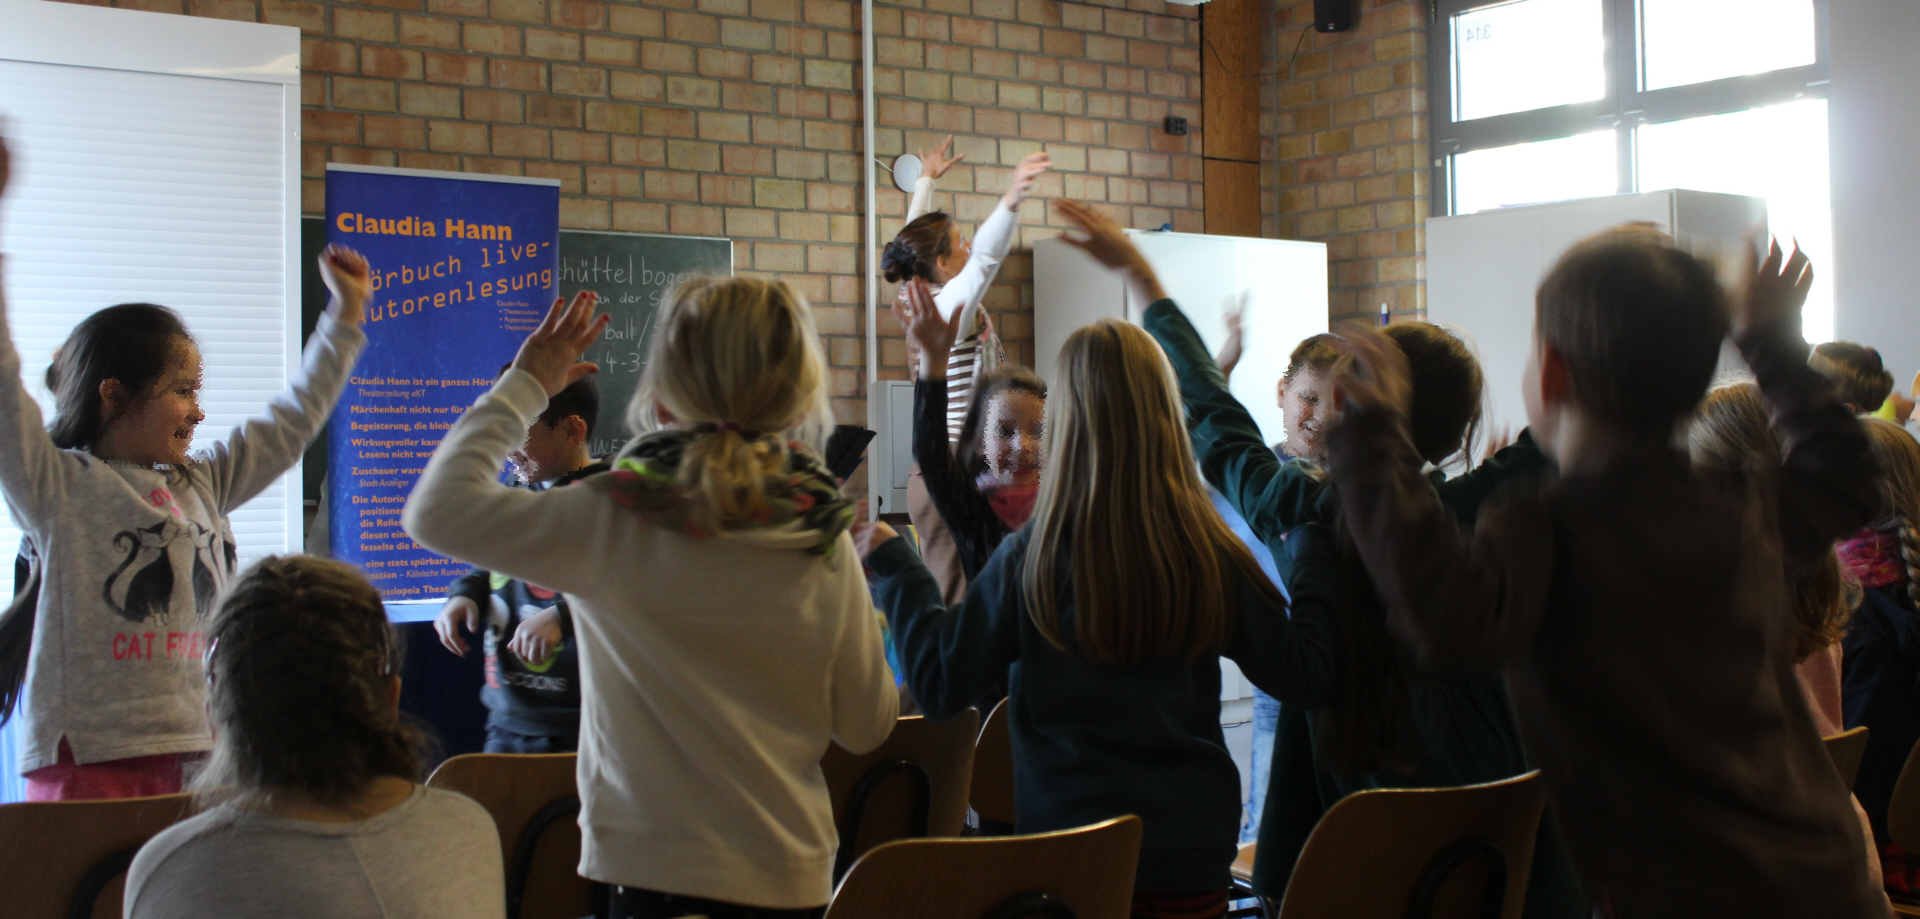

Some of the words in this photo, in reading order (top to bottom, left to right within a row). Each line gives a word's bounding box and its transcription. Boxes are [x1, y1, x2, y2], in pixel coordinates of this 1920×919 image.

[336, 212, 436, 238] Claudia
[445, 217, 512, 241] Hann
[369, 255, 462, 291] örbuch
[481, 241, 551, 268] live-
[364, 267, 552, 324] utorenlesung
[349, 376, 385, 386] Claudia
[387, 376, 410, 386] Hann
[412, 377, 424, 386] ist
[426, 377, 439, 386] ein
[440, 379, 470, 388] ganzes
[350, 405, 407, 415] Märchenhaft
[409, 405, 432, 415] nicht
[433, 407, 449, 415] nur
[450, 405, 464, 415] für
[414, 421, 427, 431] die
[391, 449, 415, 459] nicht
[351, 466, 398, 476] Zuschauer
[351, 496, 369, 505] Die
[360, 519, 374, 528] die
[396, 543, 410, 551] die
[112, 632, 156, 661] CAT
